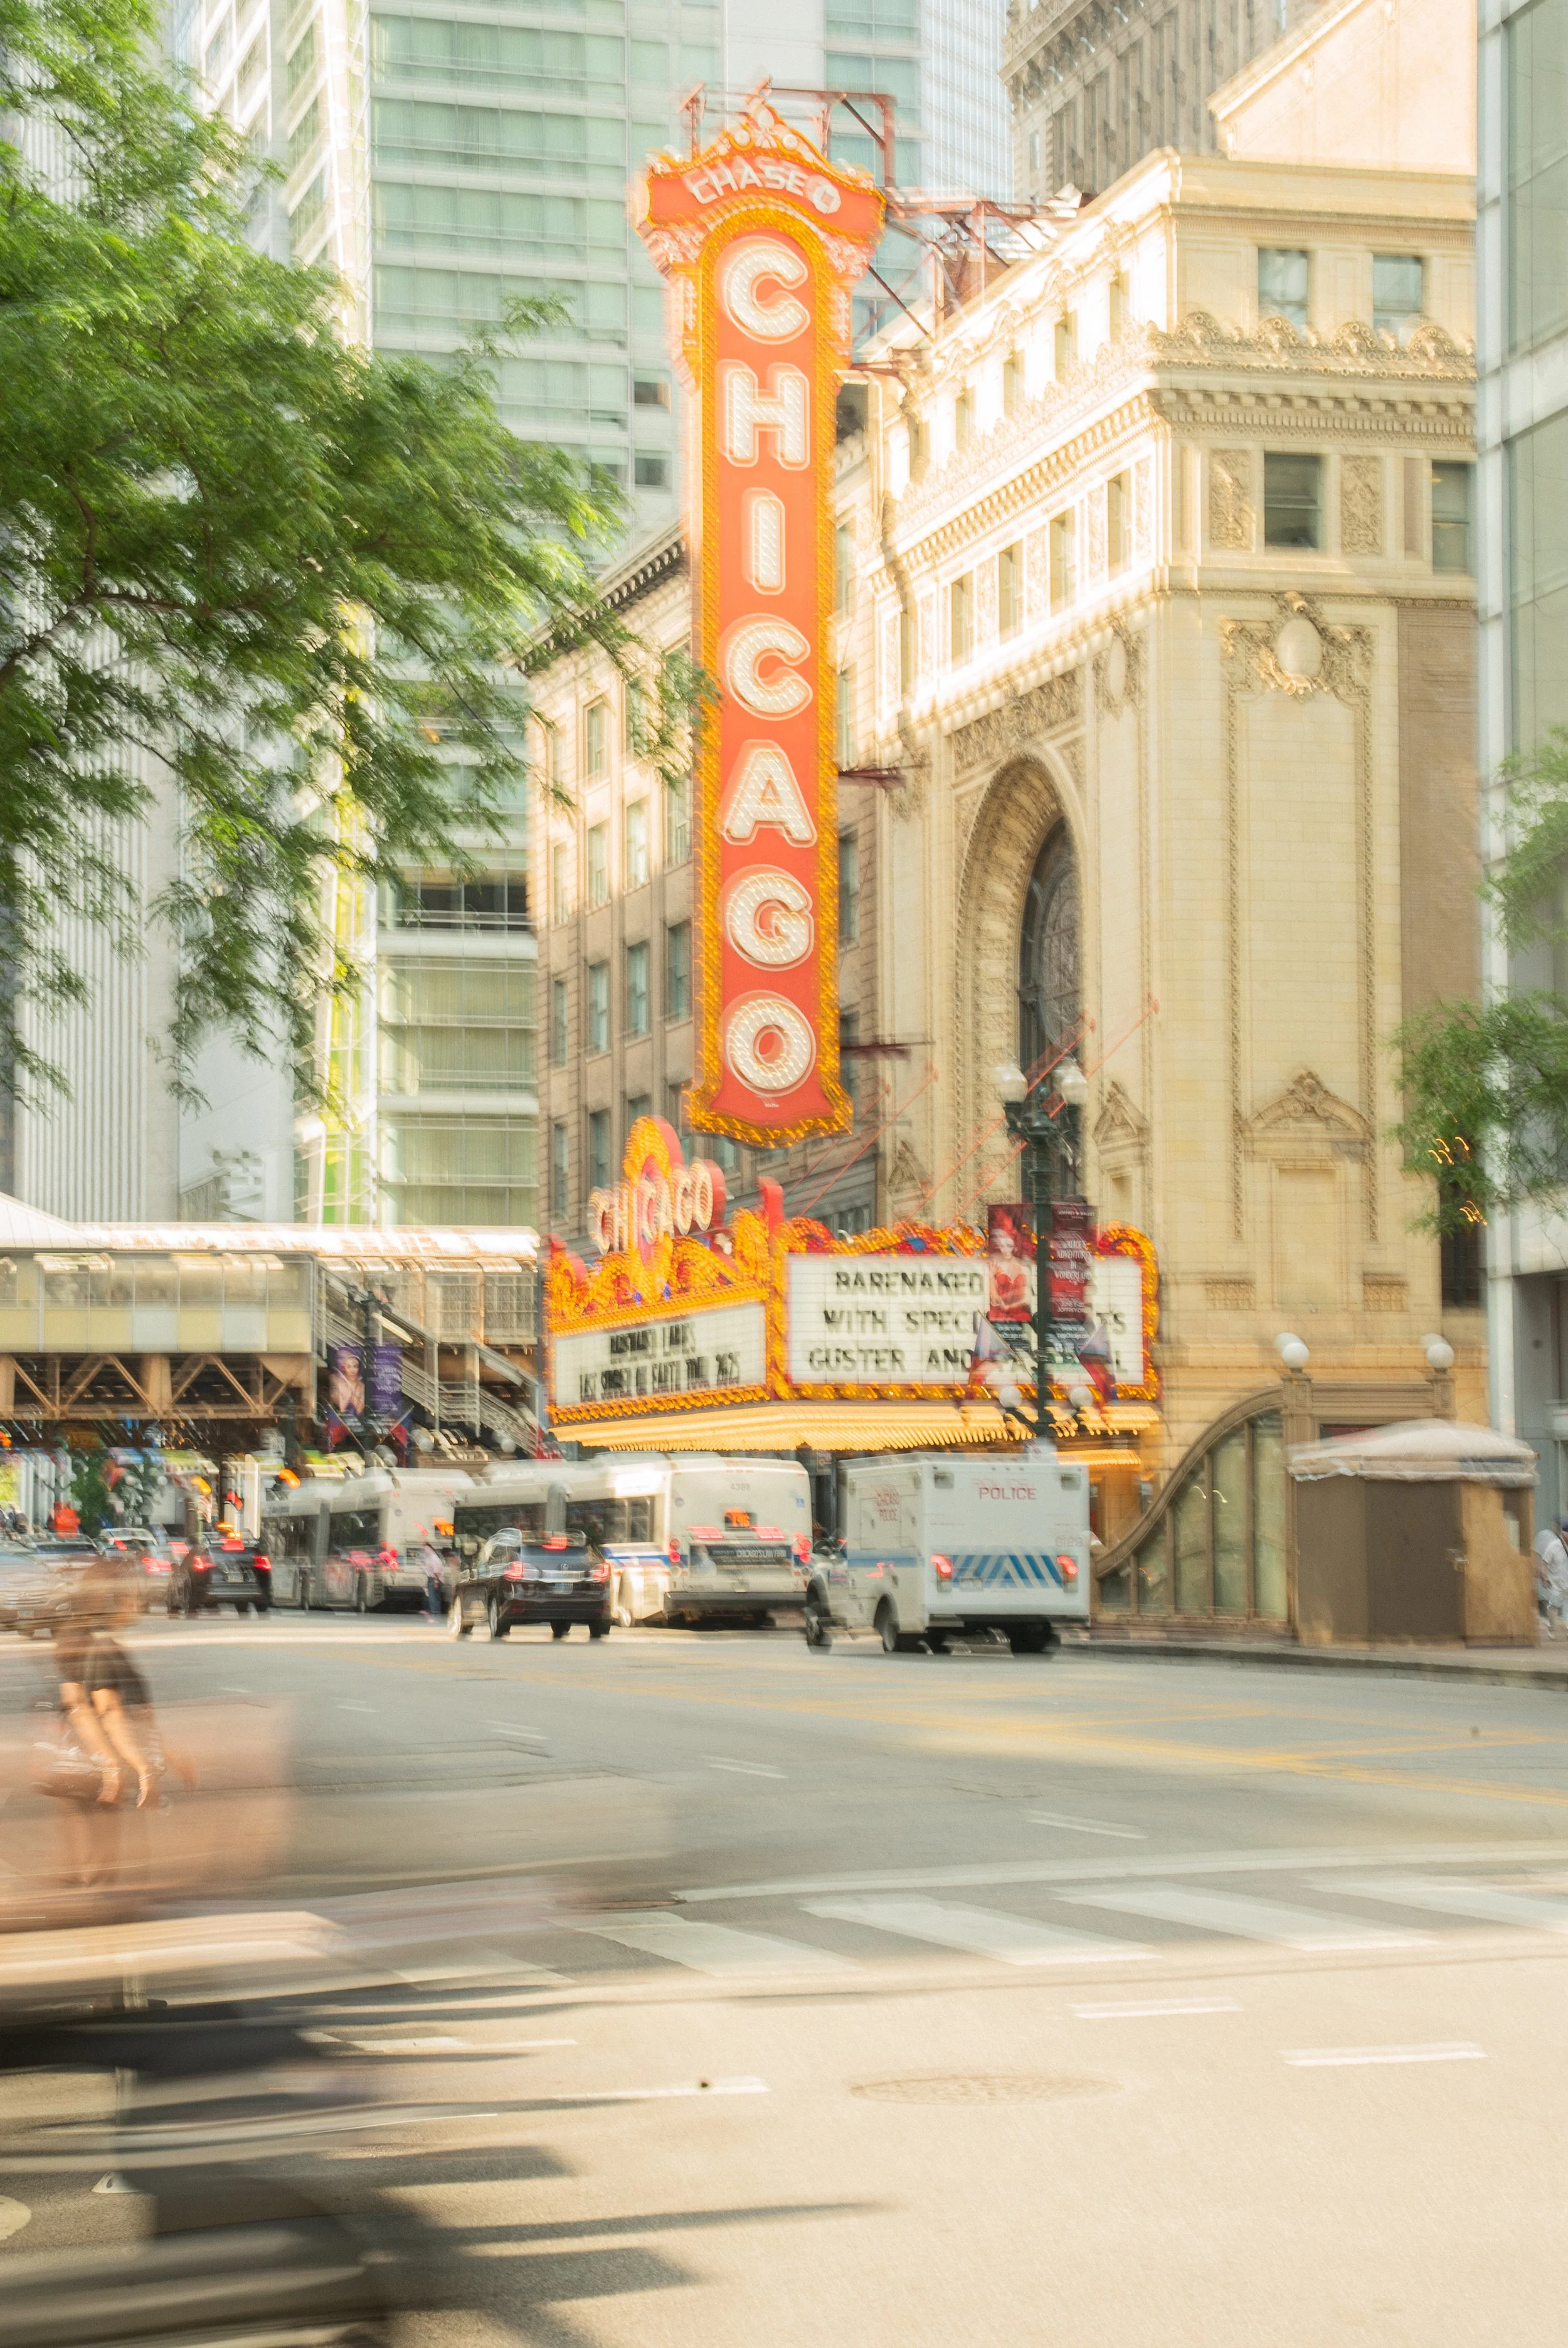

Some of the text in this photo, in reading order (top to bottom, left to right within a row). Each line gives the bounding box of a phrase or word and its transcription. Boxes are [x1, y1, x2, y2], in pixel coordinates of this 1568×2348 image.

[686, 158, 805, 205] CHASE
[719, 236, 822, 1097] CHICAGO
[587, 1158, 714, 1255] CHICAGO
[1070, 1260, 1077, 1270] IN
[835, 1272, 984, 1295] BARENAKED
[824, 1310, 978, 1334] WITH SPECI
[809, 1349, 975, 1373] GUSTER AND
[978, 1487, 1037, 1500] POLICE
